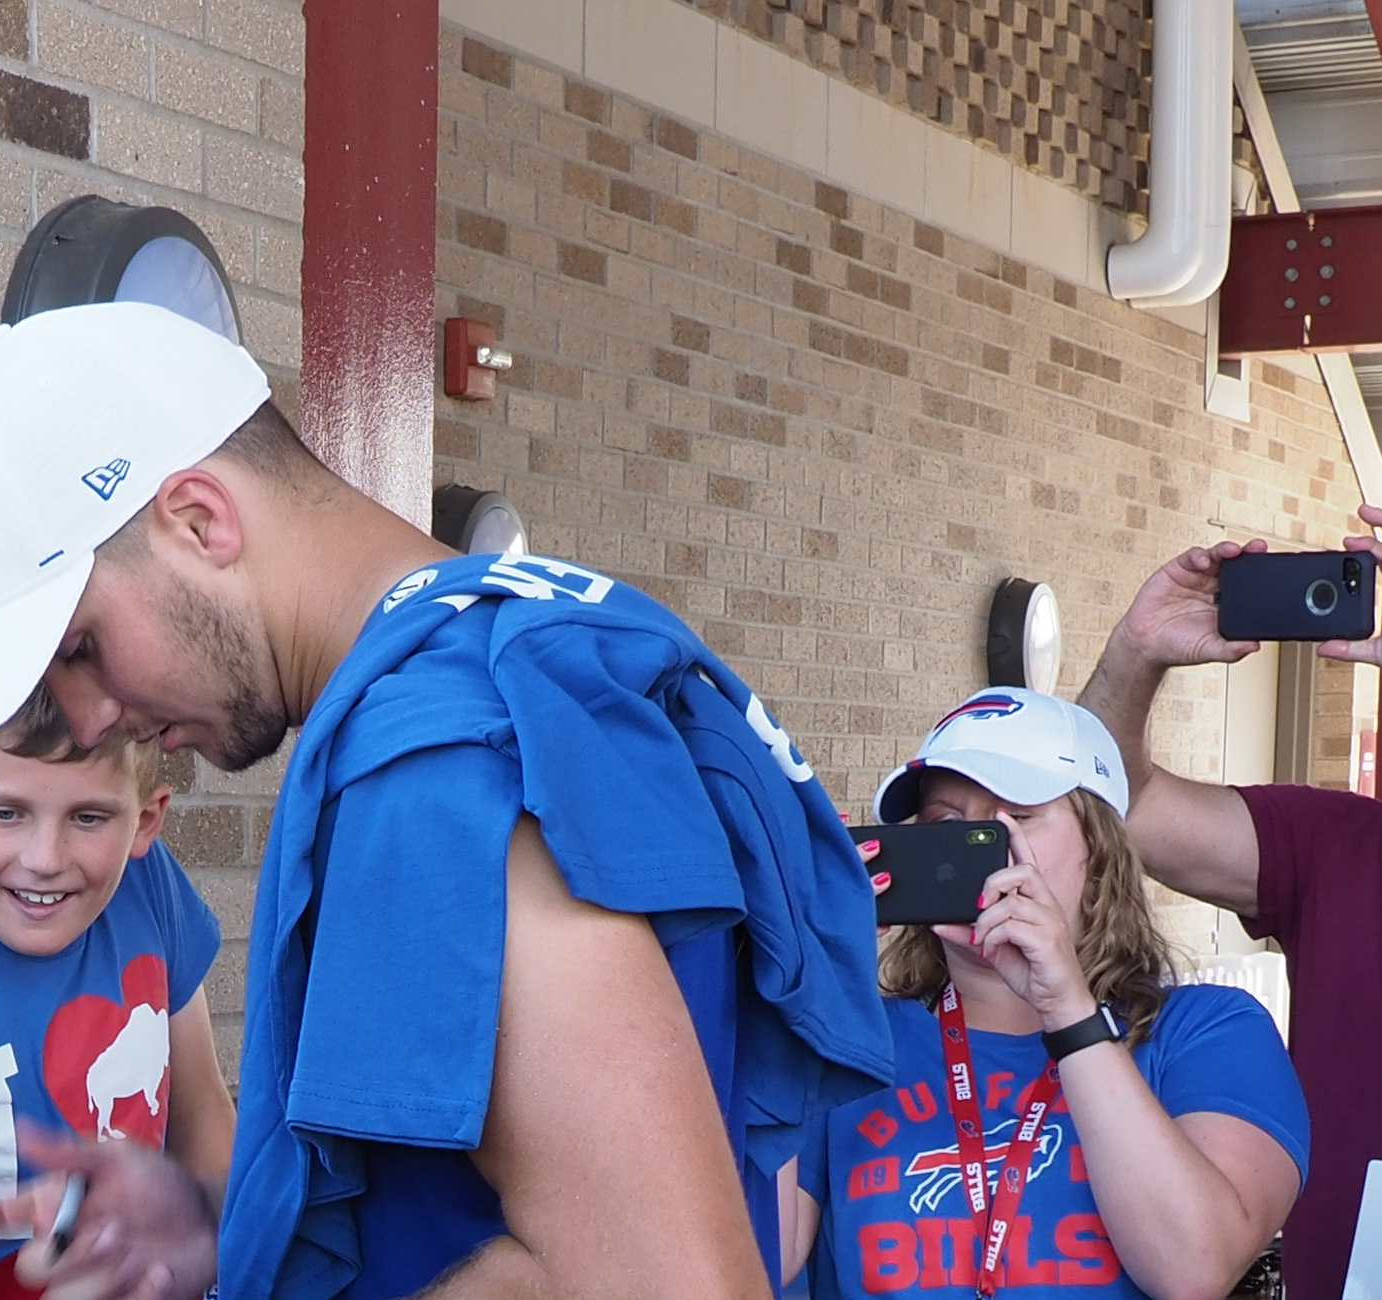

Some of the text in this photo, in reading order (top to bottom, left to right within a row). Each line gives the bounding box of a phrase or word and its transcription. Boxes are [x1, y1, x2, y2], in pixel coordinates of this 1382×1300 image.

[952, 1062, 971, 1101] BILLS
[1018, 1101, 1046, 1142] BILLS
[861, 1165, 886, 1188] 19
[966, 1161, 986, 1213] BILLS
[859, 1213, 1121, 1294] BILLS
[985, 1219, 1007, 1272] BILLS
